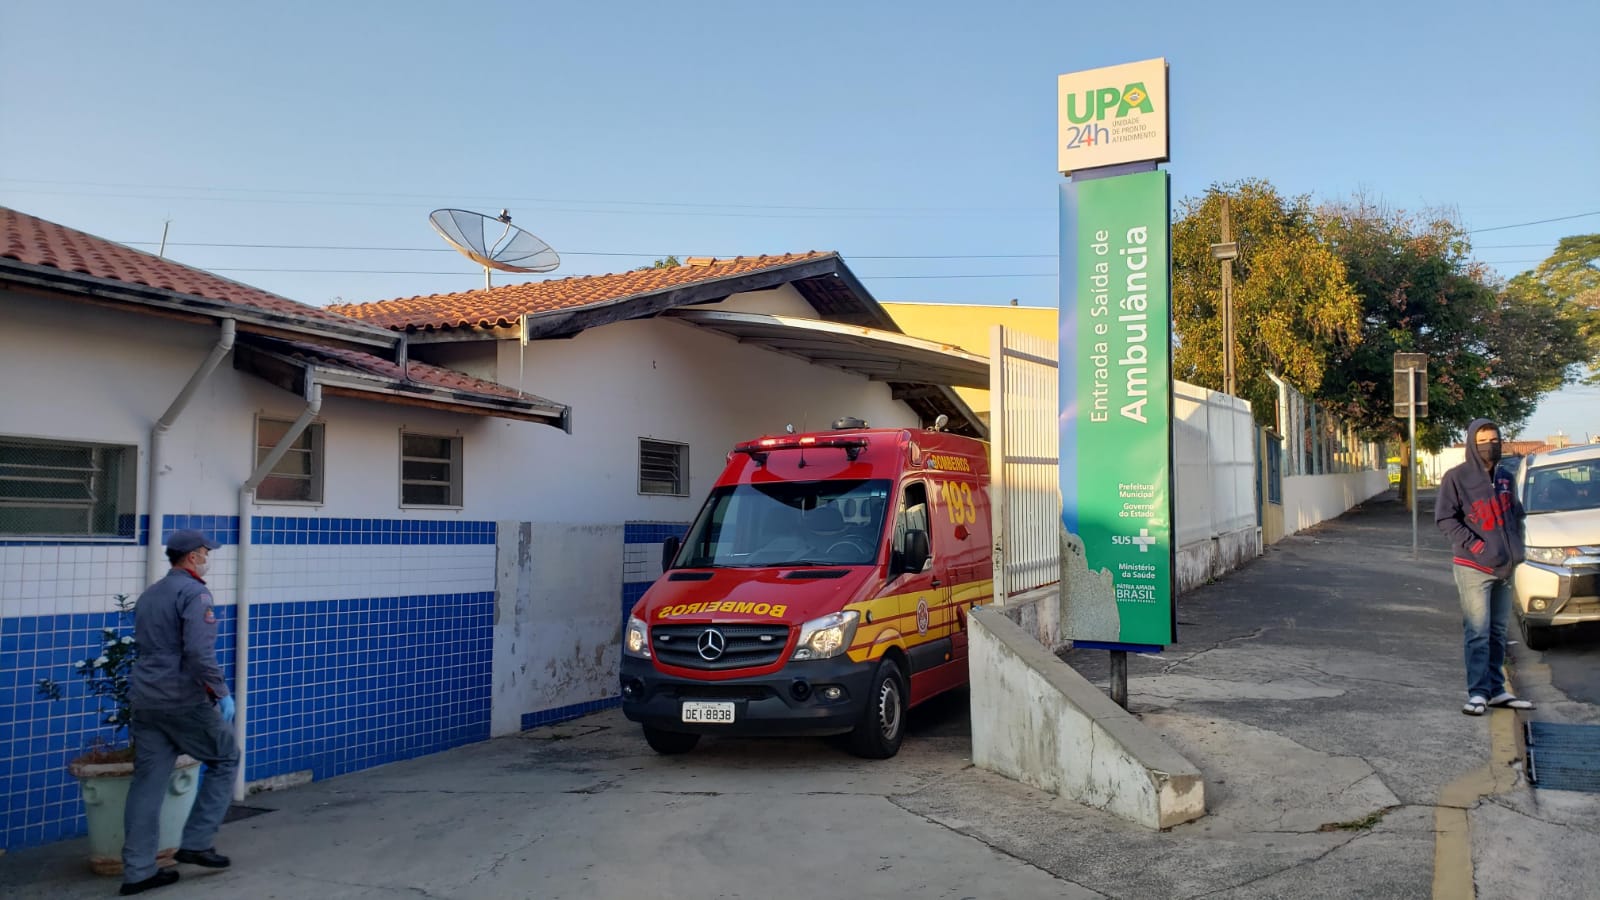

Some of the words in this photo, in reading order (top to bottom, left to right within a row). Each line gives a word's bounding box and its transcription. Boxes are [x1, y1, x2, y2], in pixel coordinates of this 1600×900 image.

[1067, 82, 1154, 124] UPA
[1112, 117, 1139, 127] UNIDADE
[1121, 124, 1147, 133] PRONTO
[1066, 123, 1109, 149] 24h
[1112, 131, 1156, 143] ATENDIMENTO
[1090, 230, 1108, 255] de
[1090, 262, 1108, 316] Saída
[1094, 323, 1108, 335] e
[1119, 226, 1148, 423] Ambulância
[1090, 342, 1108, 422] Entrada
[1119, 483, 1154, 491] Prefeitura
[1119, 491, 1154, 499] Municipal
[941, 480, 976, 524] 193
[1111, 536, 1131, 545] SUS
[1118, 563, 1156, 572] Ministério
[1133, 571, 1156, 579] Saúde
[1116, 589, 1156, 600] BRASIL
